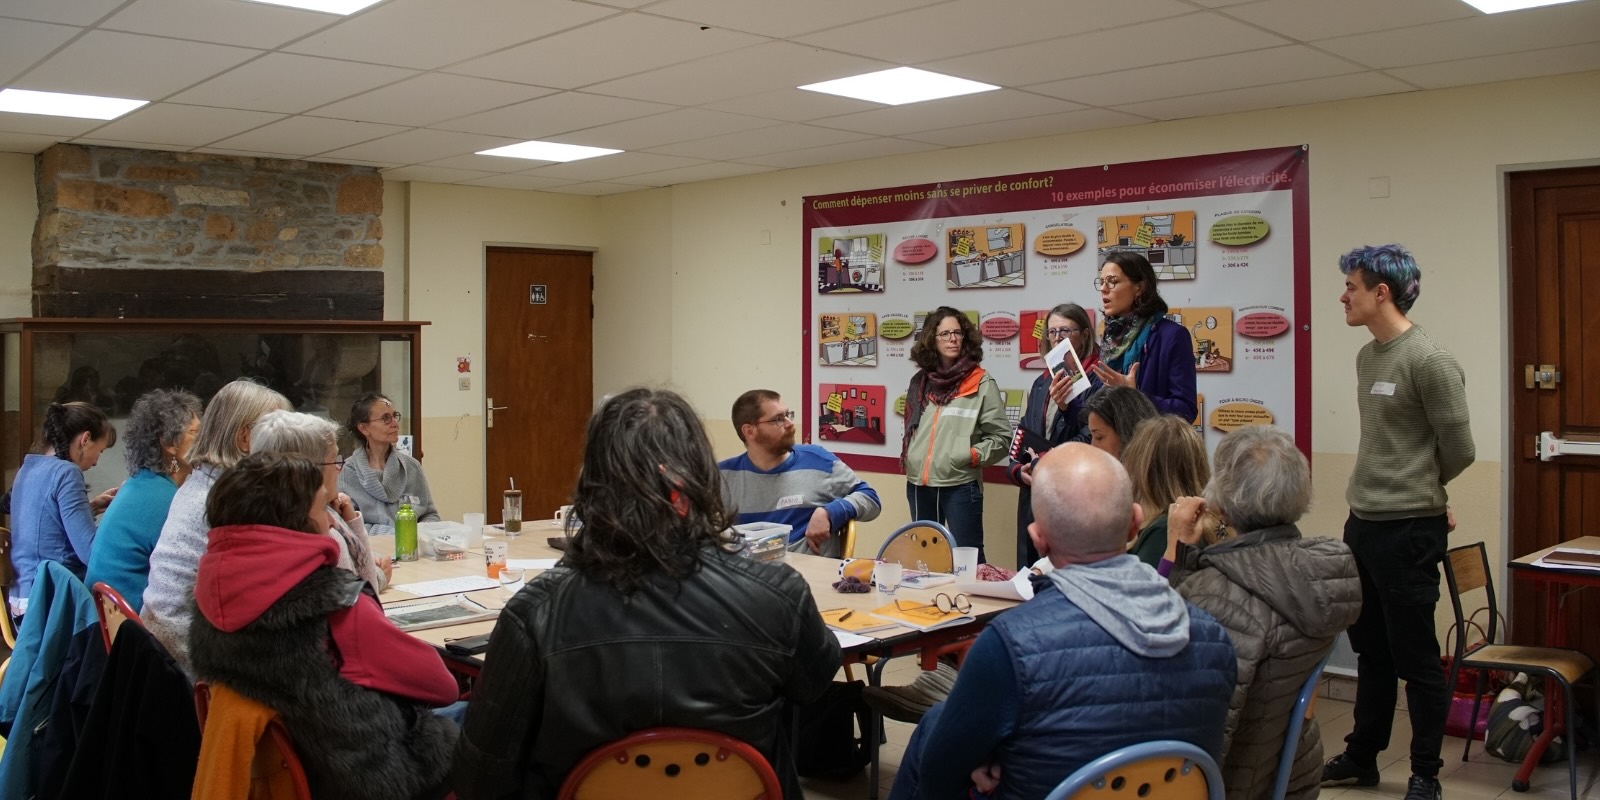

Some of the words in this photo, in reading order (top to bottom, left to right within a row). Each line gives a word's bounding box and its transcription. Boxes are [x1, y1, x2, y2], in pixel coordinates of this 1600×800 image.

[812, 198, 850, 210] Comment
[850, 195, 892, 208] dépenser
[894, 192, 925, 202] moins
[926, 189, 948, 198] sans
[950, 187, 961, 197] se
[962, 183, 992, 198] priver
[994, 181, 1008, 192] de
[1009, 176, 1054, 191] confort?
[1051, 191, 1064, 202] 10
[1066, 186, 1117, 203] exemples
[1119, 187, 1145, 201] pour
[1148, 178, 1217, 194] économiser
